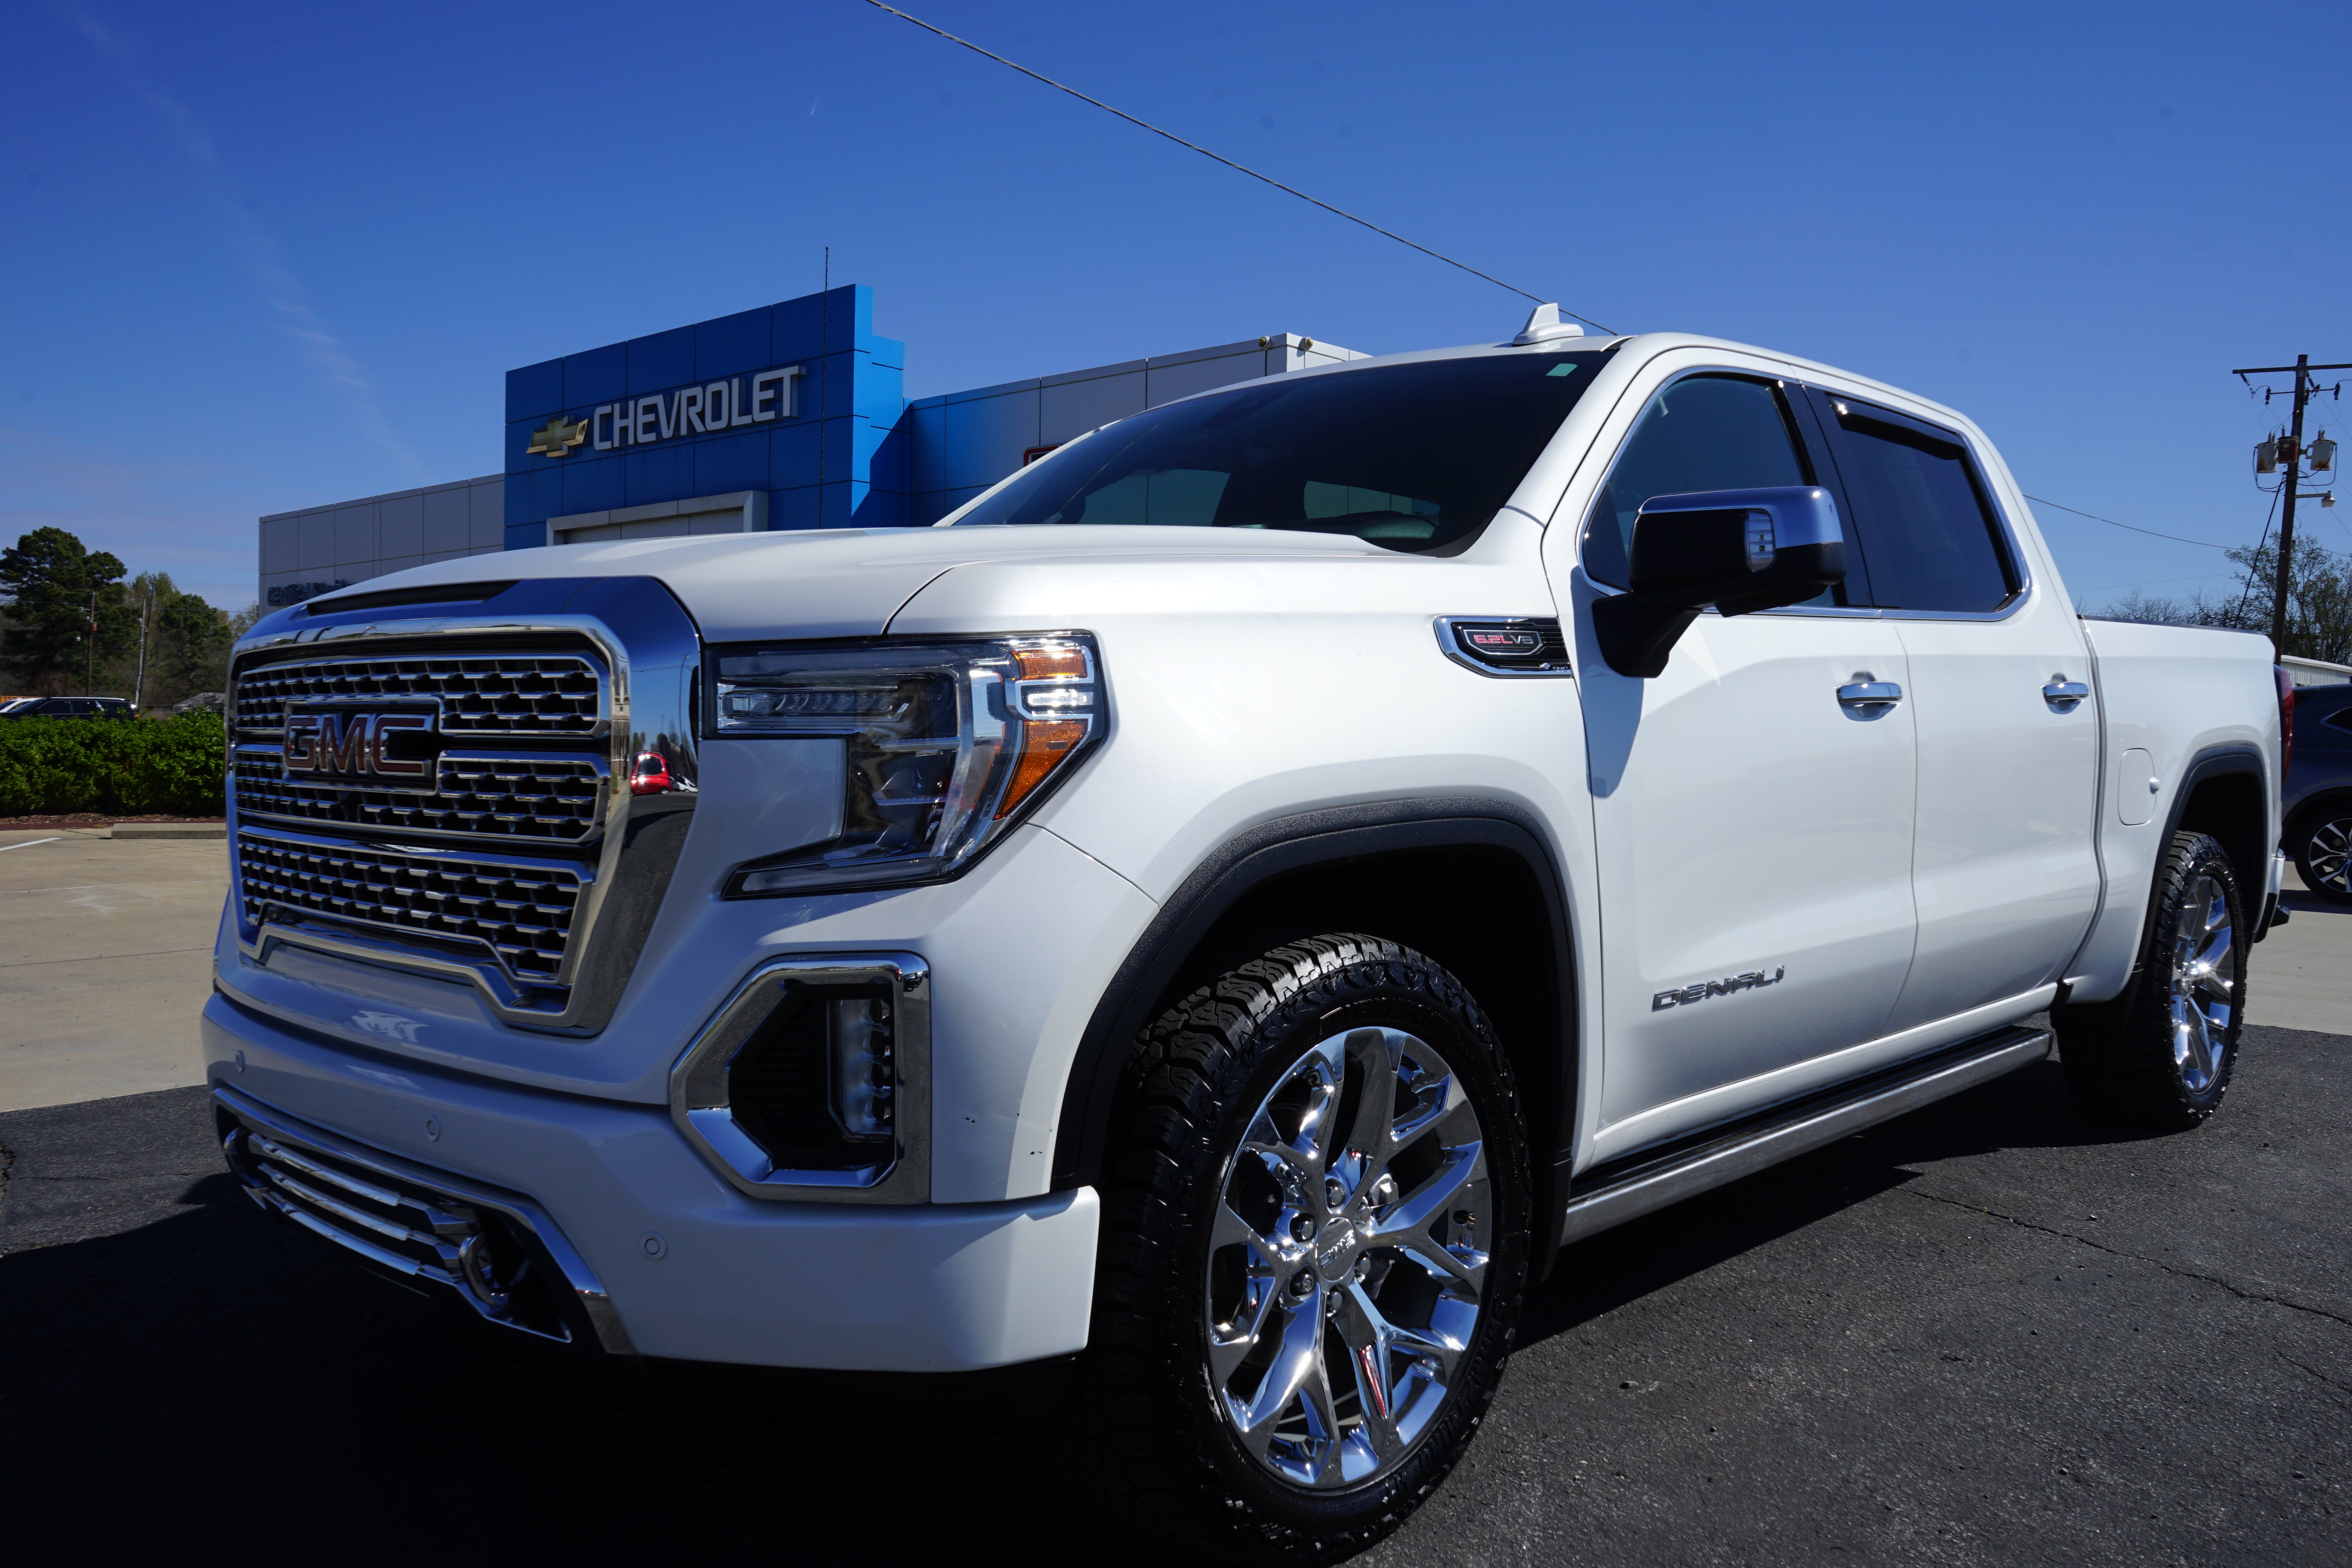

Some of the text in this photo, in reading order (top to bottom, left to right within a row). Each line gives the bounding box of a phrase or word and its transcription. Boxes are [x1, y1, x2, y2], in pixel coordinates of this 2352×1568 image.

[593, 365, 807, 451] CHEVROLET
[284, 713, 435, 777] GMC
[1651, 965, 1784, 1013] DENALI
